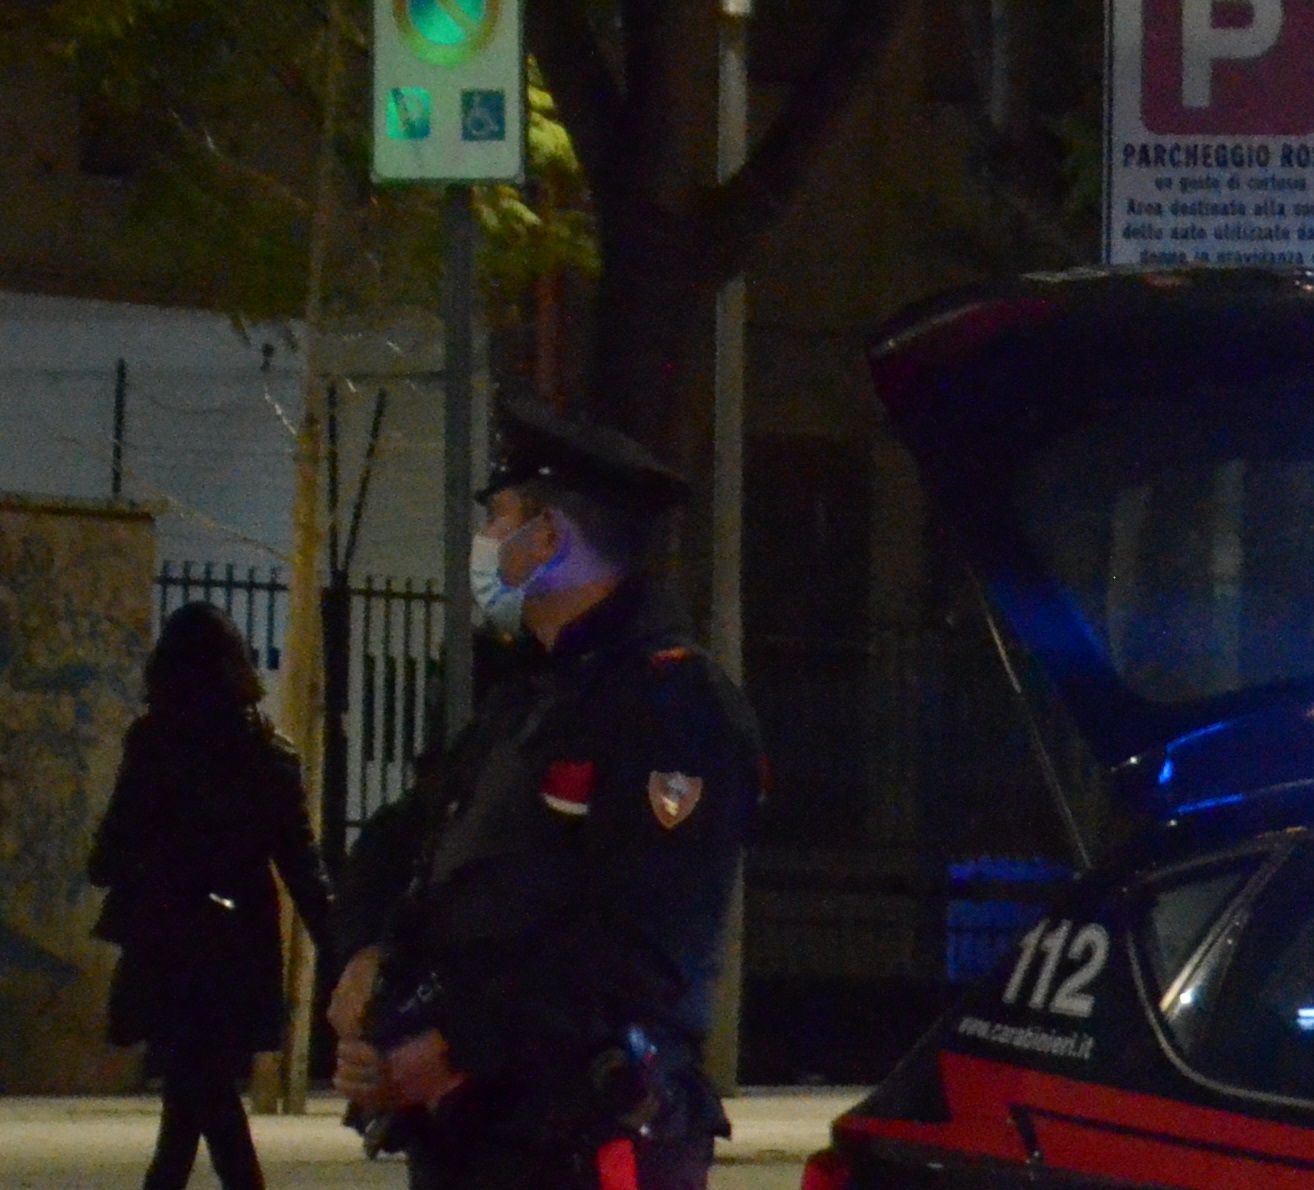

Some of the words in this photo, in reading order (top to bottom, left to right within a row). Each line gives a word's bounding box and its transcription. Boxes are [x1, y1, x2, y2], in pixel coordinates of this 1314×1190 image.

[1182, 0, 1284, 108] P
[1122, 143, 1270, 168] PARCHEGGIO
[1126, 198, 1163, 216] Area
[1254, 200, 1286, 216] alla
[1170, 223, 1207, 240] auto
[1002, 918, 1109, 1018] 112
